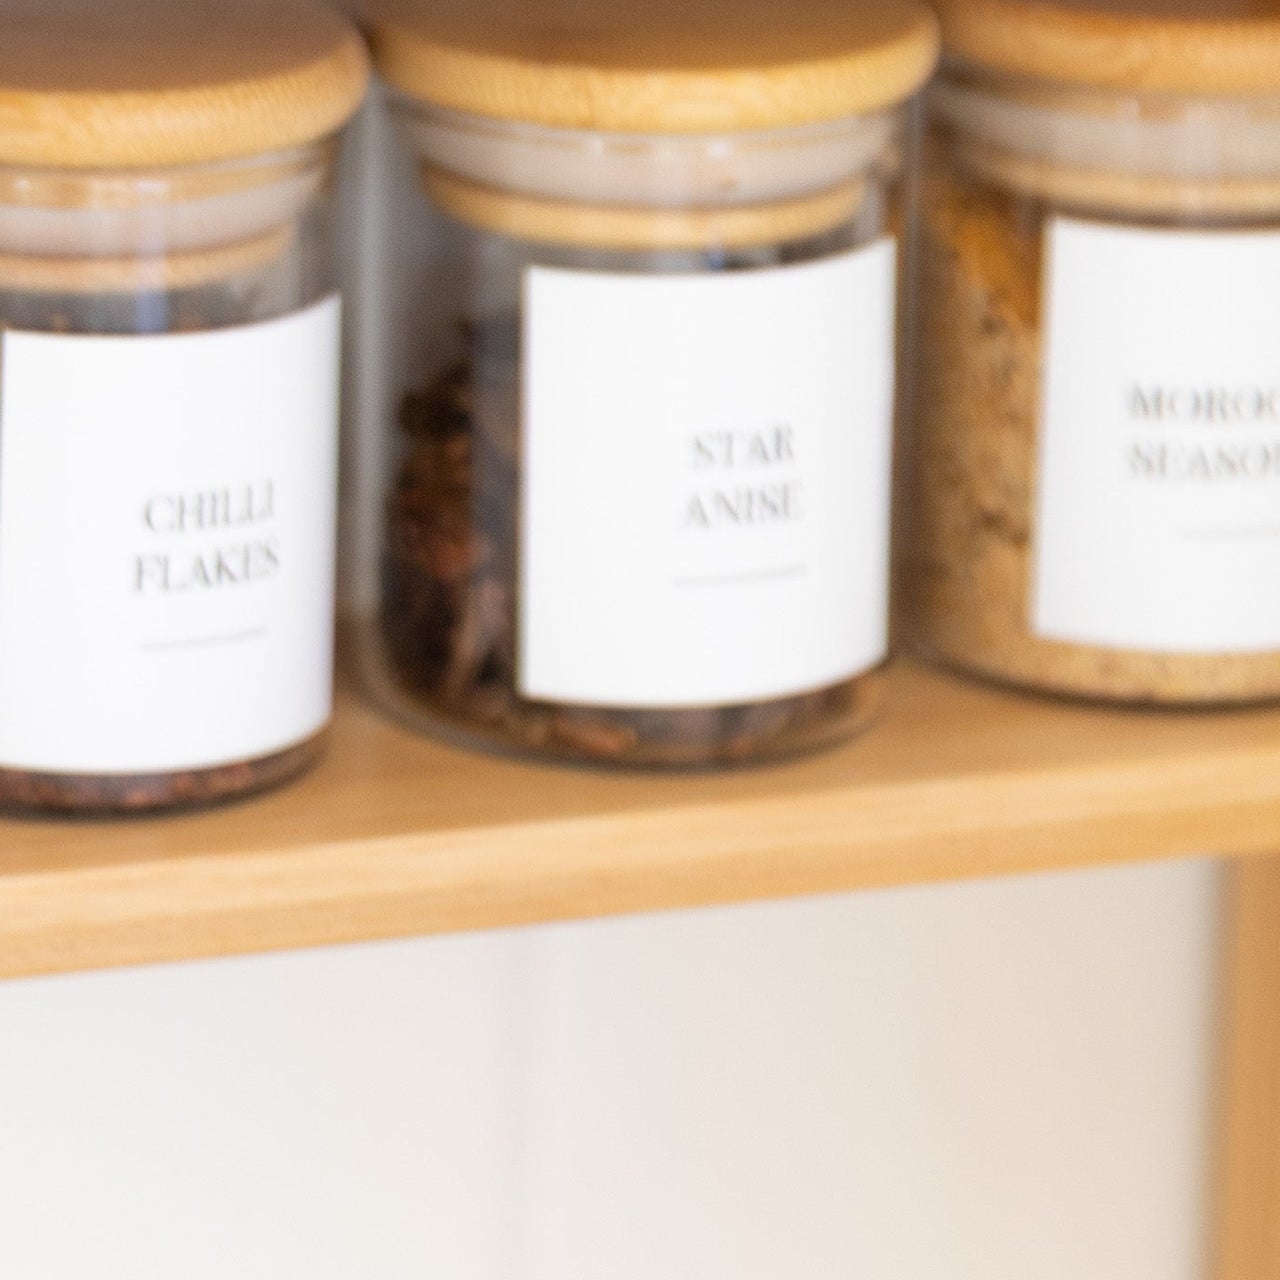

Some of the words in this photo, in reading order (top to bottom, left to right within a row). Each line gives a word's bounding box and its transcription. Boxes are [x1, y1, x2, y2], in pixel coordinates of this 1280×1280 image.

[692, 423, 794, 468] STAR
[144, 480, 276, 533] CHILLI
[686, 481, 798, 528] ANISE
[134, 543, 281, 592] FLAKES
